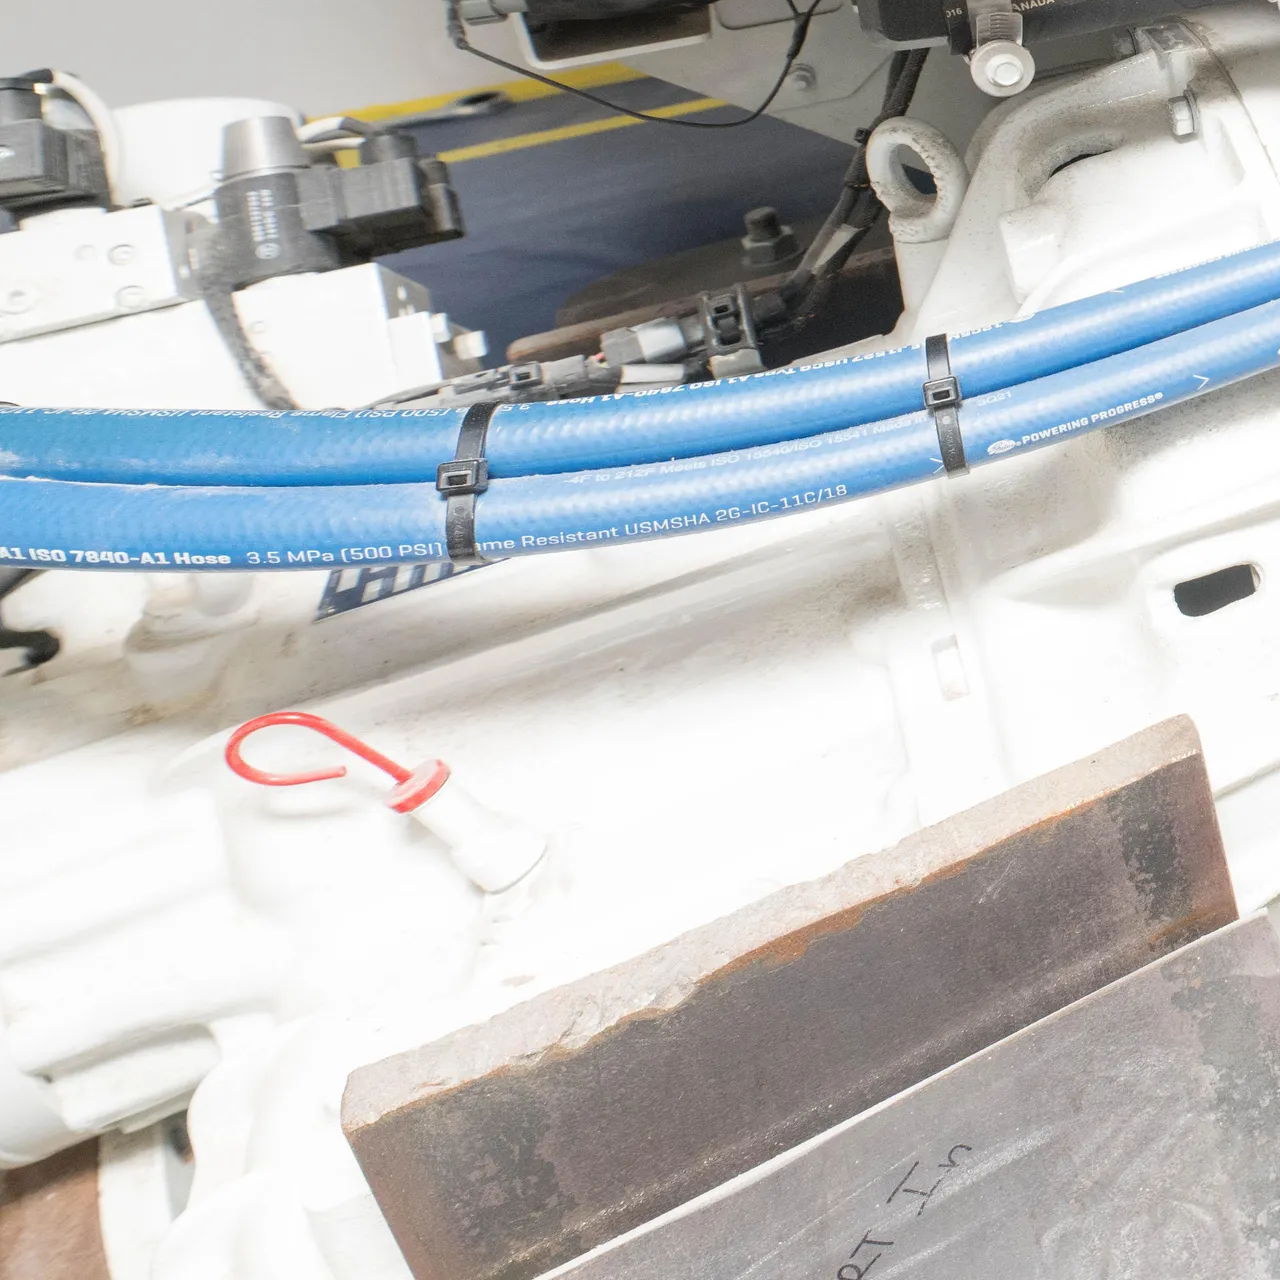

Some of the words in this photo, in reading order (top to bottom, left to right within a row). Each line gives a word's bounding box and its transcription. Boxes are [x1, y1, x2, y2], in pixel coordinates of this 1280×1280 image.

[726, 372, 751, 385] A1
[544, 393, 596, 409] Hose
[600, 382, 685, 402] 7840-A1
[190, 407, 285, 418] Resistant
[292, 407, 351, 417] Flame
[1021, 417, 1089, 445] POWERING
[594, 471, 610, 482] to
[619, 465, 656, 480] 212F
[660, 458, 705, 474] Meets
[709, 453, 740, 466] ISO
[745, 438, 822, 462] 15540/ISO
[828, 427, 869, 446] 15541
[871, 417, 914, 435] Made
[247, 551, 280, 564] 3.5
[287, 549, 334, 563] MPa
[472, 536, 516, 552] ame
[521, 524, 620, 548] Resistant
[625, 513, 710, 536] USMSHA
[715, 483, 848, 522] 2G-IC-11C/18
[0, 547, 25, 561] A1
[28, 548, 66, 563] ISO
[70, 550, 170, 565] 7840-A1
[174, 552, 231, 565] Hose
